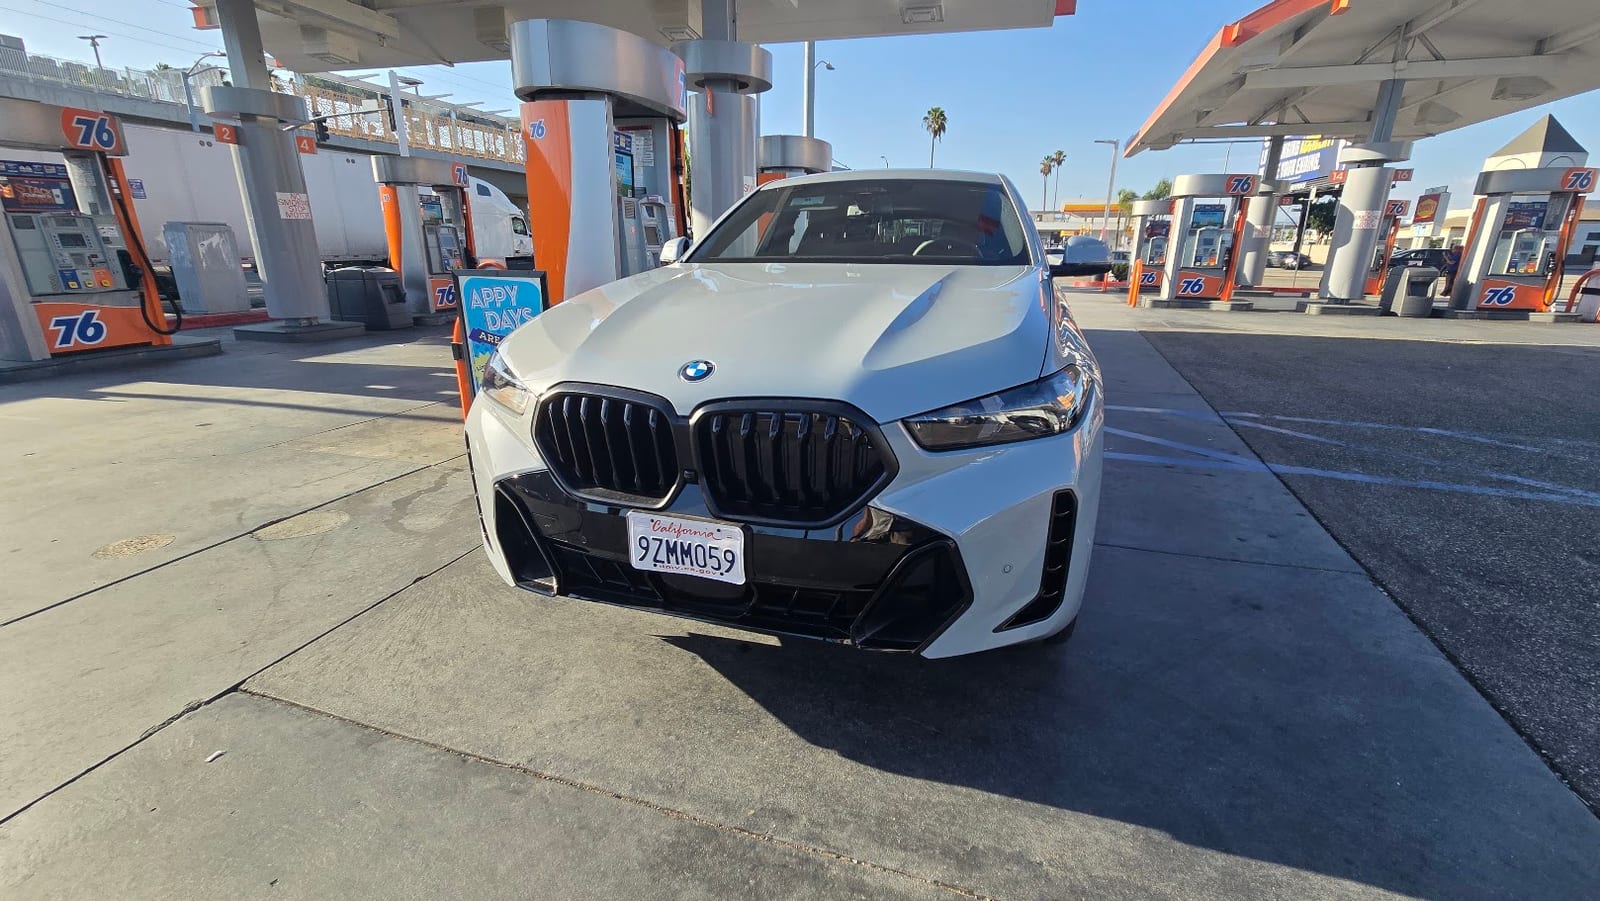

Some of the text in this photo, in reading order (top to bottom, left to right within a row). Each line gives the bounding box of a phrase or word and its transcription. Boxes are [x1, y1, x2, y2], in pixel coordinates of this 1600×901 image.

[73, 115, 117, 149] 76
[221, 127, 231, 140] 2
[528, 119, 546, 140] 76
[299, 139, 310, 151] 4
[455, 166, 469, 186] 76
[1229, 175, 1253, 194] 76
[1332, 171, 1344, 183] 14
[1397, 169, 1409, 180] 16
[1565, 170, 1593, 191] 76
[1389, 202, 1406, 214] 76
[1140, 272, 1157, 285] 76
[1178, 277, 1205, 296] 76
[435, 284, 456, 307] 76
[471, 284, 518, 309] APPY
[1481, 285, 1516, 307] 76
[49, 309, 107, 348] 76
[484, 307, 533, 331] DAYS
[479, 331, 501, 344] ARE
[651, 519, 723, 541] California
[638, 535, 736, 574] 9ZMM059
